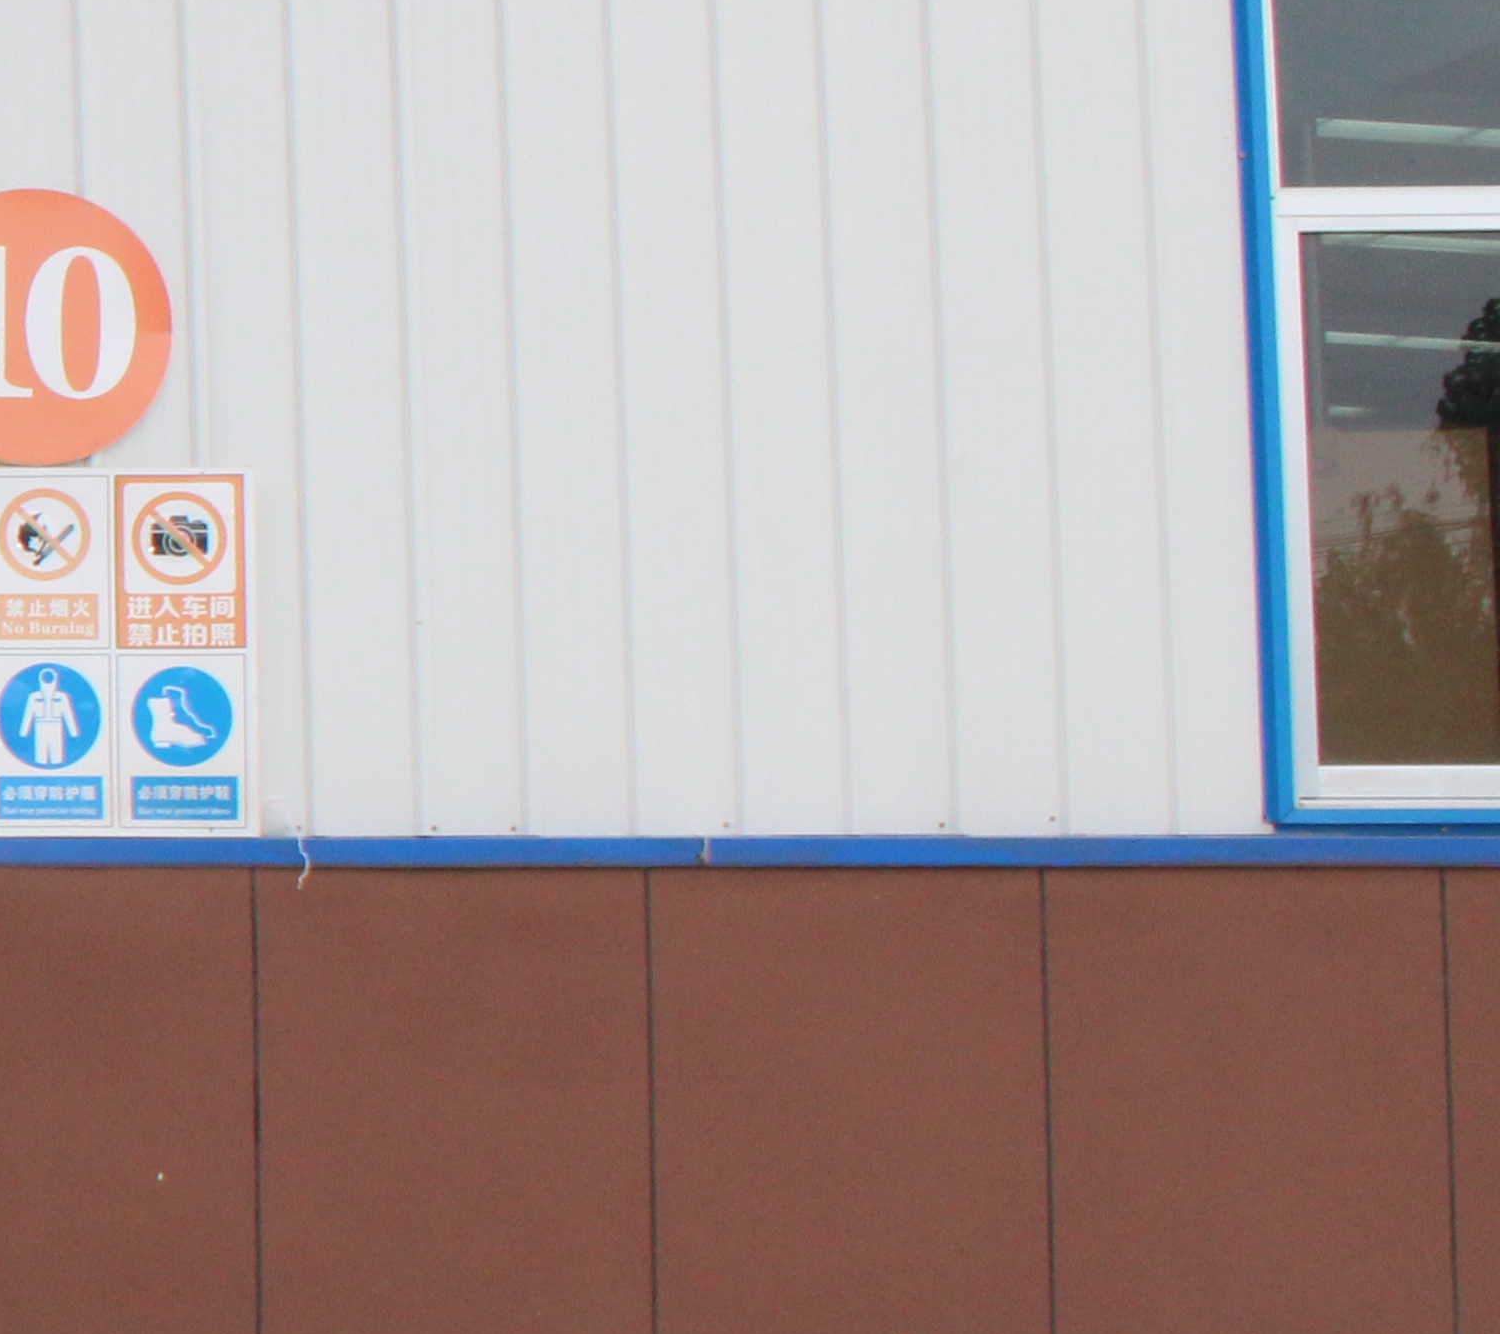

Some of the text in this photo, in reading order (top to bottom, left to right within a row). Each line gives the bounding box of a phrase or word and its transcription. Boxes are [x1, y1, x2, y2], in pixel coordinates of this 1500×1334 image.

[5, 598, 91, 618] 禁止烟火
[126, 595, 236, 619] 进入车间
[1, 621, 96, 637] No Burning
[127, 622, 237, 647] 禁止拍照
